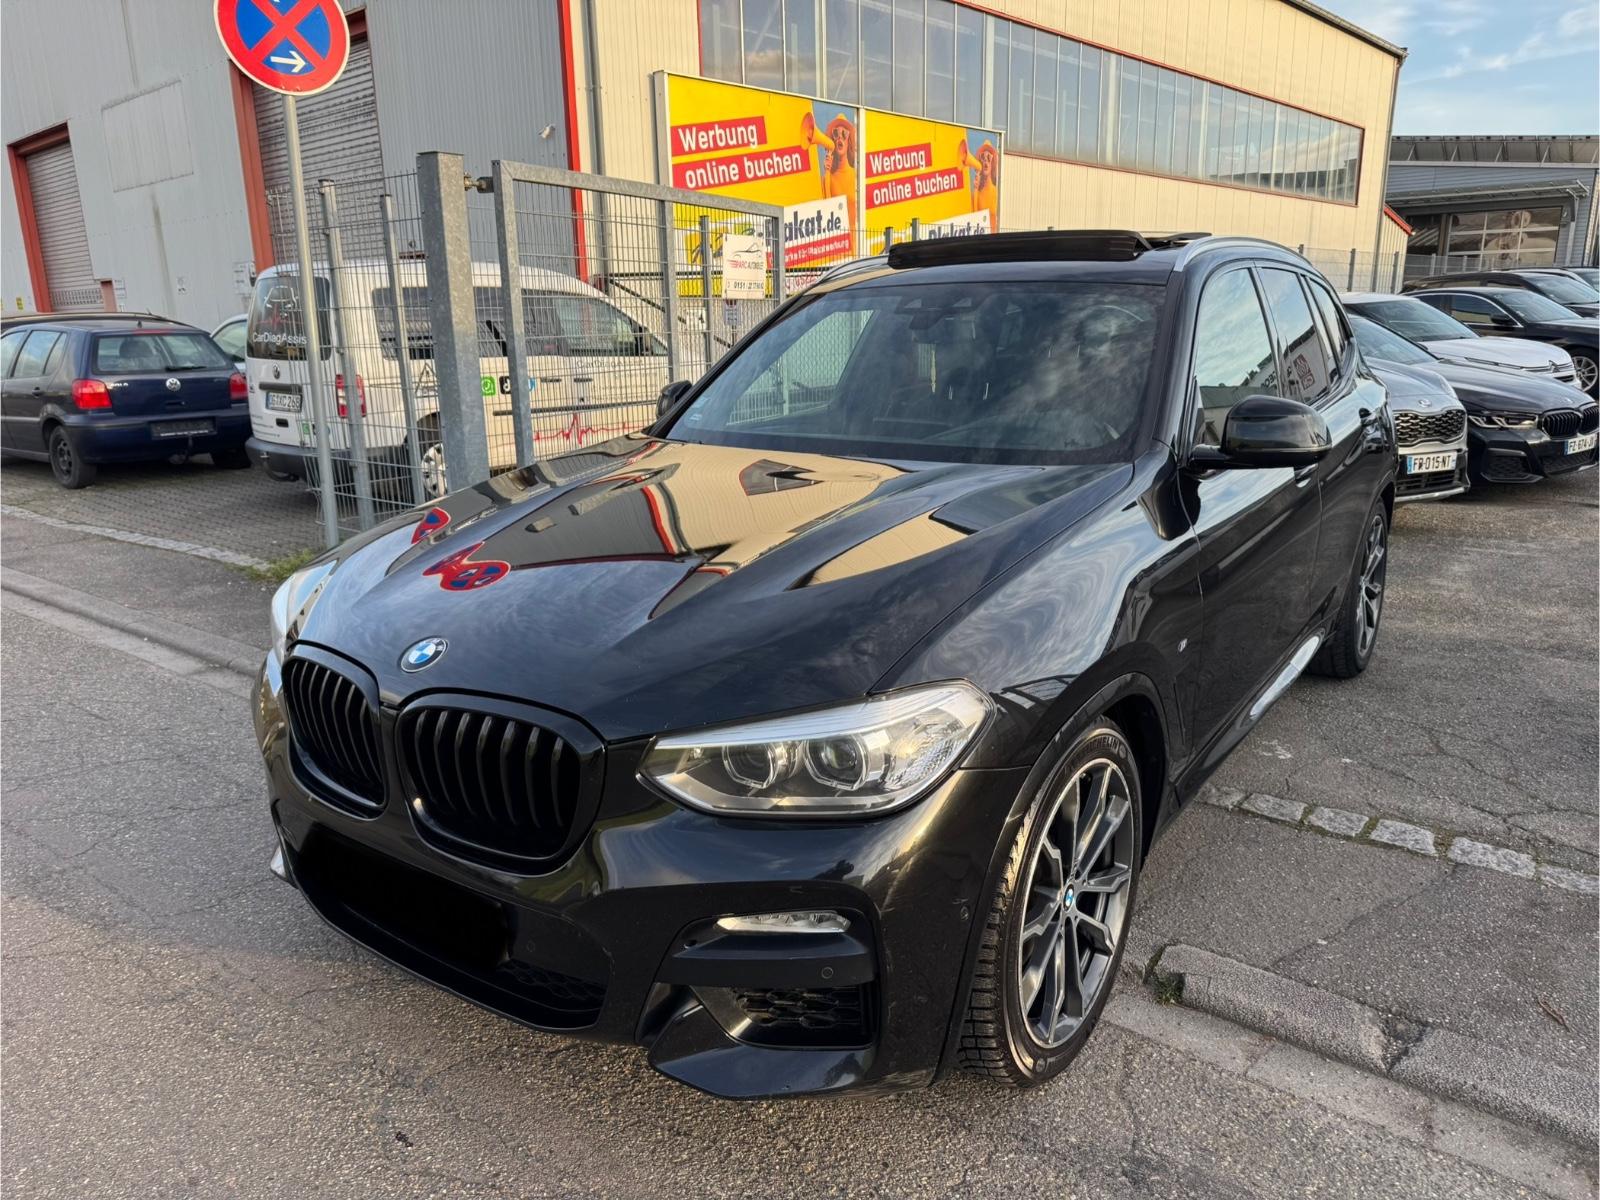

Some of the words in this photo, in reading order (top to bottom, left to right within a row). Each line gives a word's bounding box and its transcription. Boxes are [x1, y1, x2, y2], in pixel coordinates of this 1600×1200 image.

[678, 123, 758, 152] Werbung
[685, 162, 740, 189] online
[744, 152, 802, 178] buchen
[870, 150, 926, 174] Werbung
[873, 182, 912, 205] online
[915, 173, 958, 195] buchen
[765, 209, 841, 248] Pakat.de
[929, 222, 985, 239] Plkatde
[252, 331, 308, 345] CarDiagAssis
